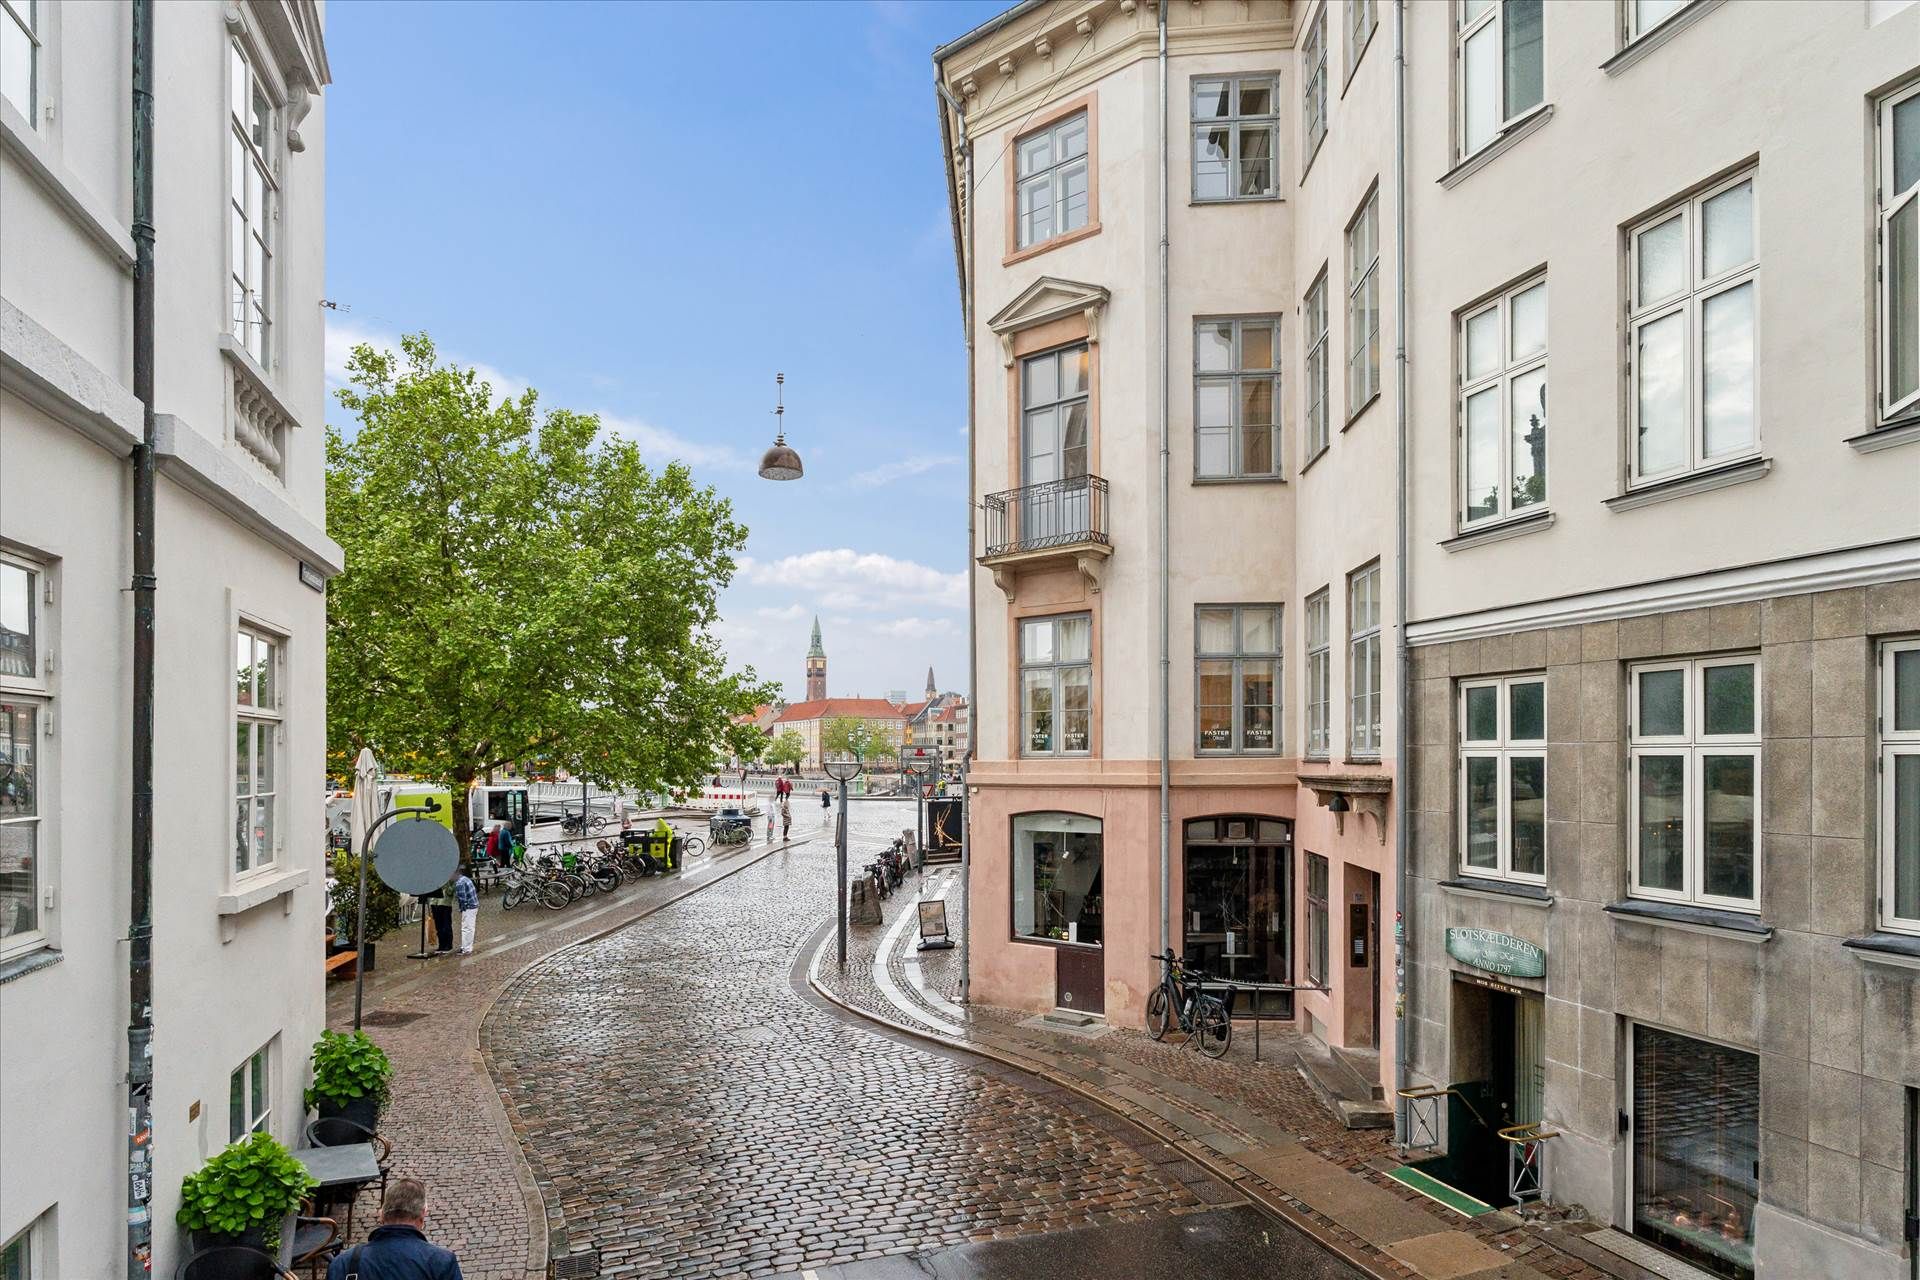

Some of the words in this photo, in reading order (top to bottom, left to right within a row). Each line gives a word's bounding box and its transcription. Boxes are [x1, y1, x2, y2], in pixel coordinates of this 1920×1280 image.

[1449, 928, 1540, 959] SLOTSKÆLDEREN
[1473, 957, 1496, 971] ANNO
[1496, 963, 1512, 973] 1797
